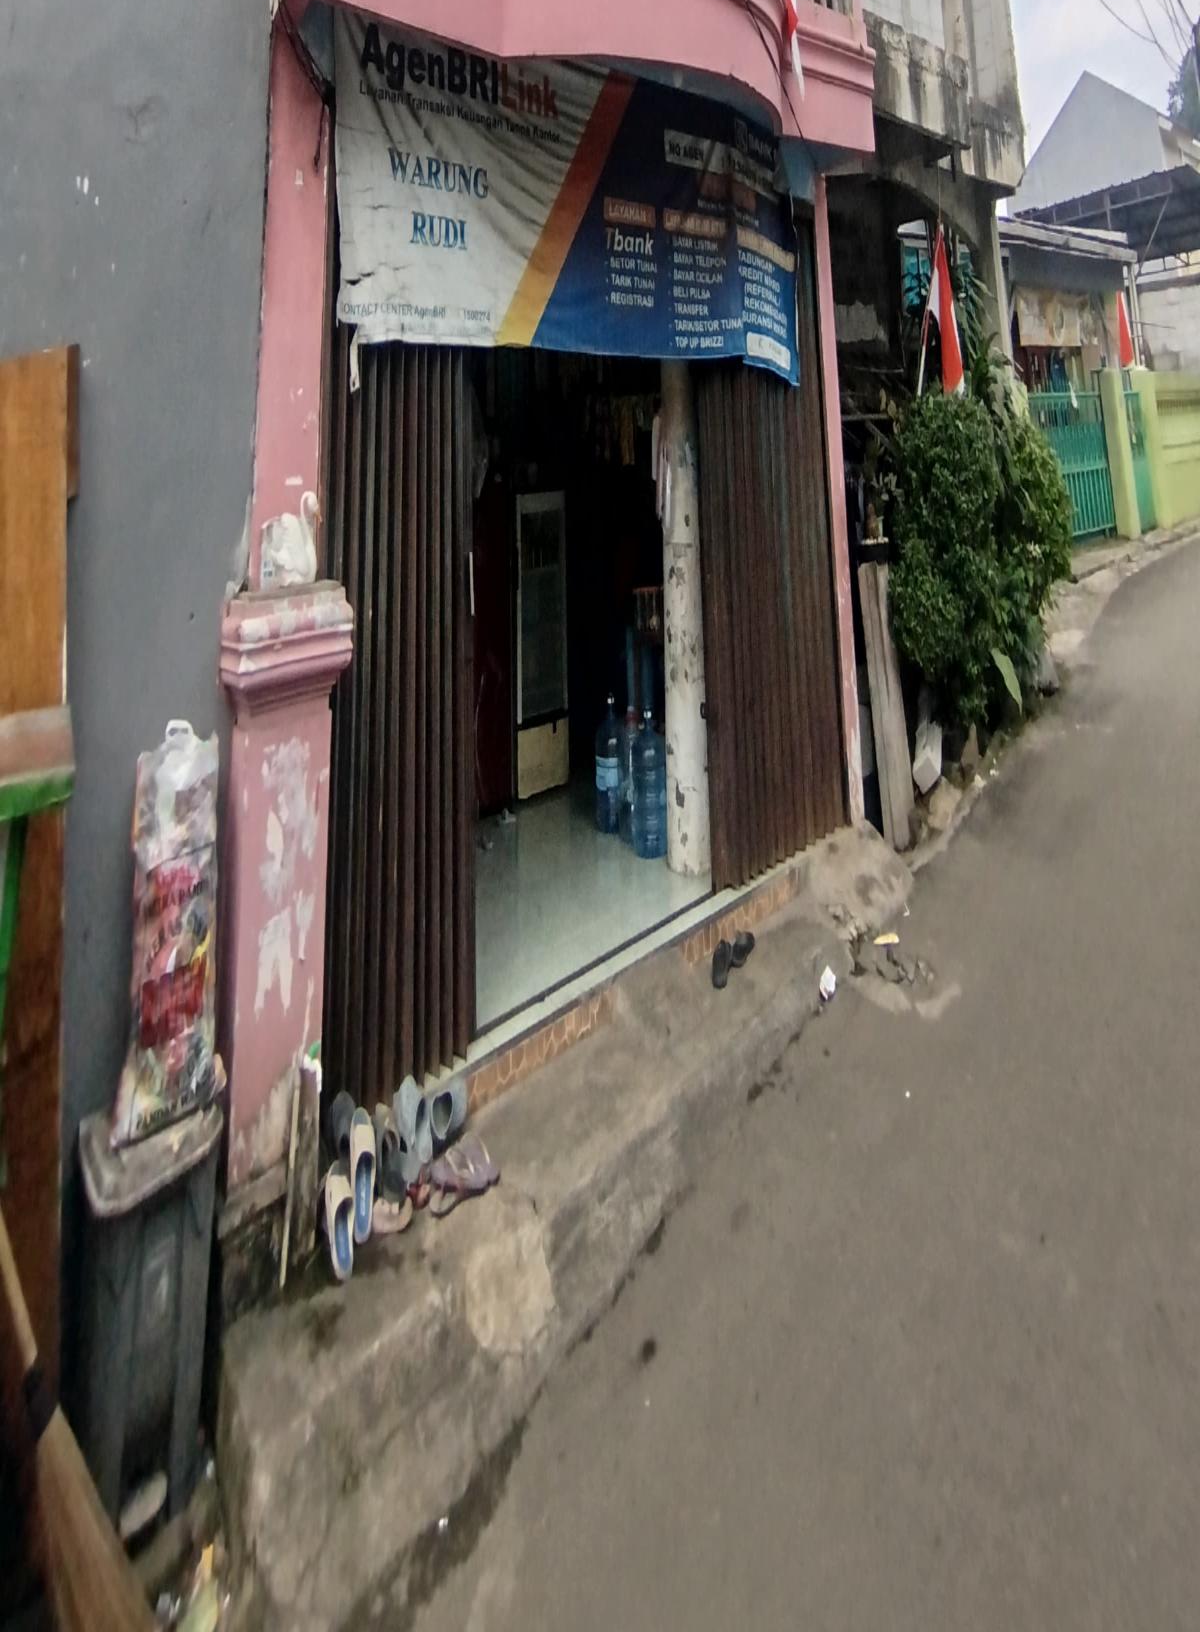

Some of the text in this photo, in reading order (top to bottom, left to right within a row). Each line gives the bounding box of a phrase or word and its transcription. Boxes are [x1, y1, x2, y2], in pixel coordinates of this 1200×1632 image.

[405, 93, 454, 117] Transaksi
[388, 147, 489, 199] WARUNG
[410, 211, 468, 250] RUDI
[610, 257, 657, 273] SETOR TUNAI
[611, 274, 655, 290] TARIK TUNAI
[674, 269, 694, 281] BAYAR
[610, 292, 655, 307] REGISTRASI
[380, 303, 413, 315] CENTER
[674, 303, 709, 316] TRANSFER
[675, 336, 689, 348] TOP
